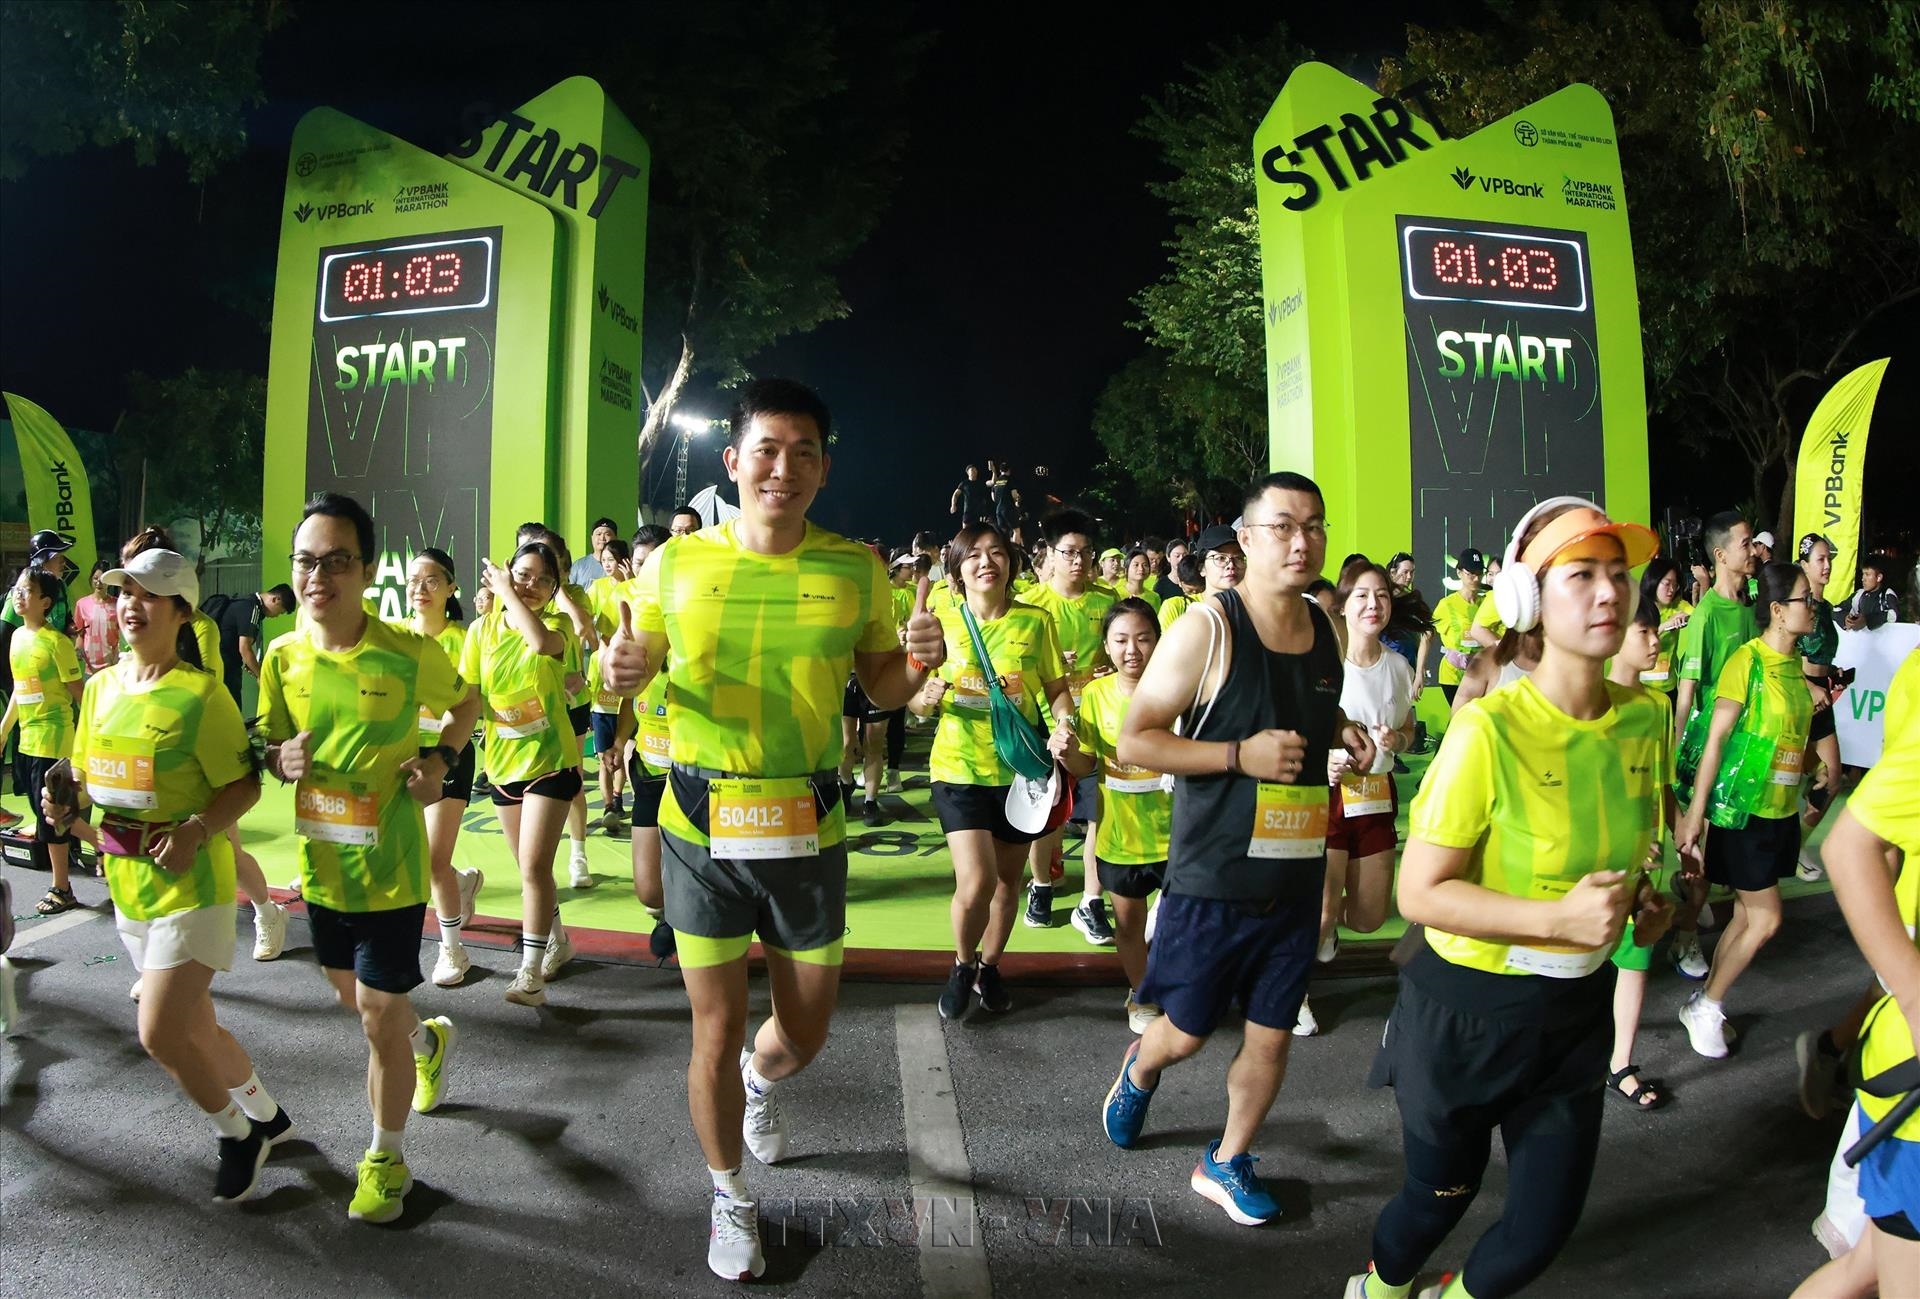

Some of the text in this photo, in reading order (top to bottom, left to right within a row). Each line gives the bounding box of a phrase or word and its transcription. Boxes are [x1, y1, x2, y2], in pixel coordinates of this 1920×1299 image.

[1262, 80, 1449, 212] START
[395, 192, 449, 205] INTERNATIONAL
[406, 182, 449, 197] VPBANK
[1479, 176, 1544, 199] VPBank
[1565, 189, 1615, 202] INTERNATIONAL
[1572, 181, 1613, 195] VPBANK
[317, 200, 375, 221] VPBank
[395, 199, 449, 214] MARATHON
[1566, 197, 1616, 211] MARATHON
[343, 253, 461, 302] 01:03
[1434, 241, 1558, 292] 01:03
[1278, 287, 1303, 323] VPBank
[610, 301, 639, 334] VPBank
[335, 337, 466, 390] START
[1437, 330, 1572, 384] START
[607, 361, 632, 385] VPBANK
[600, 386, 632, 411] MARATHON
[1823, 431, 1849, 528] VPBank
[88, 756, 127, 779] 51214
[300, 790, 346, 816] 50588
[718, 804, 784, 828] 50412
[1263, 808, 1311, 830] 52117
